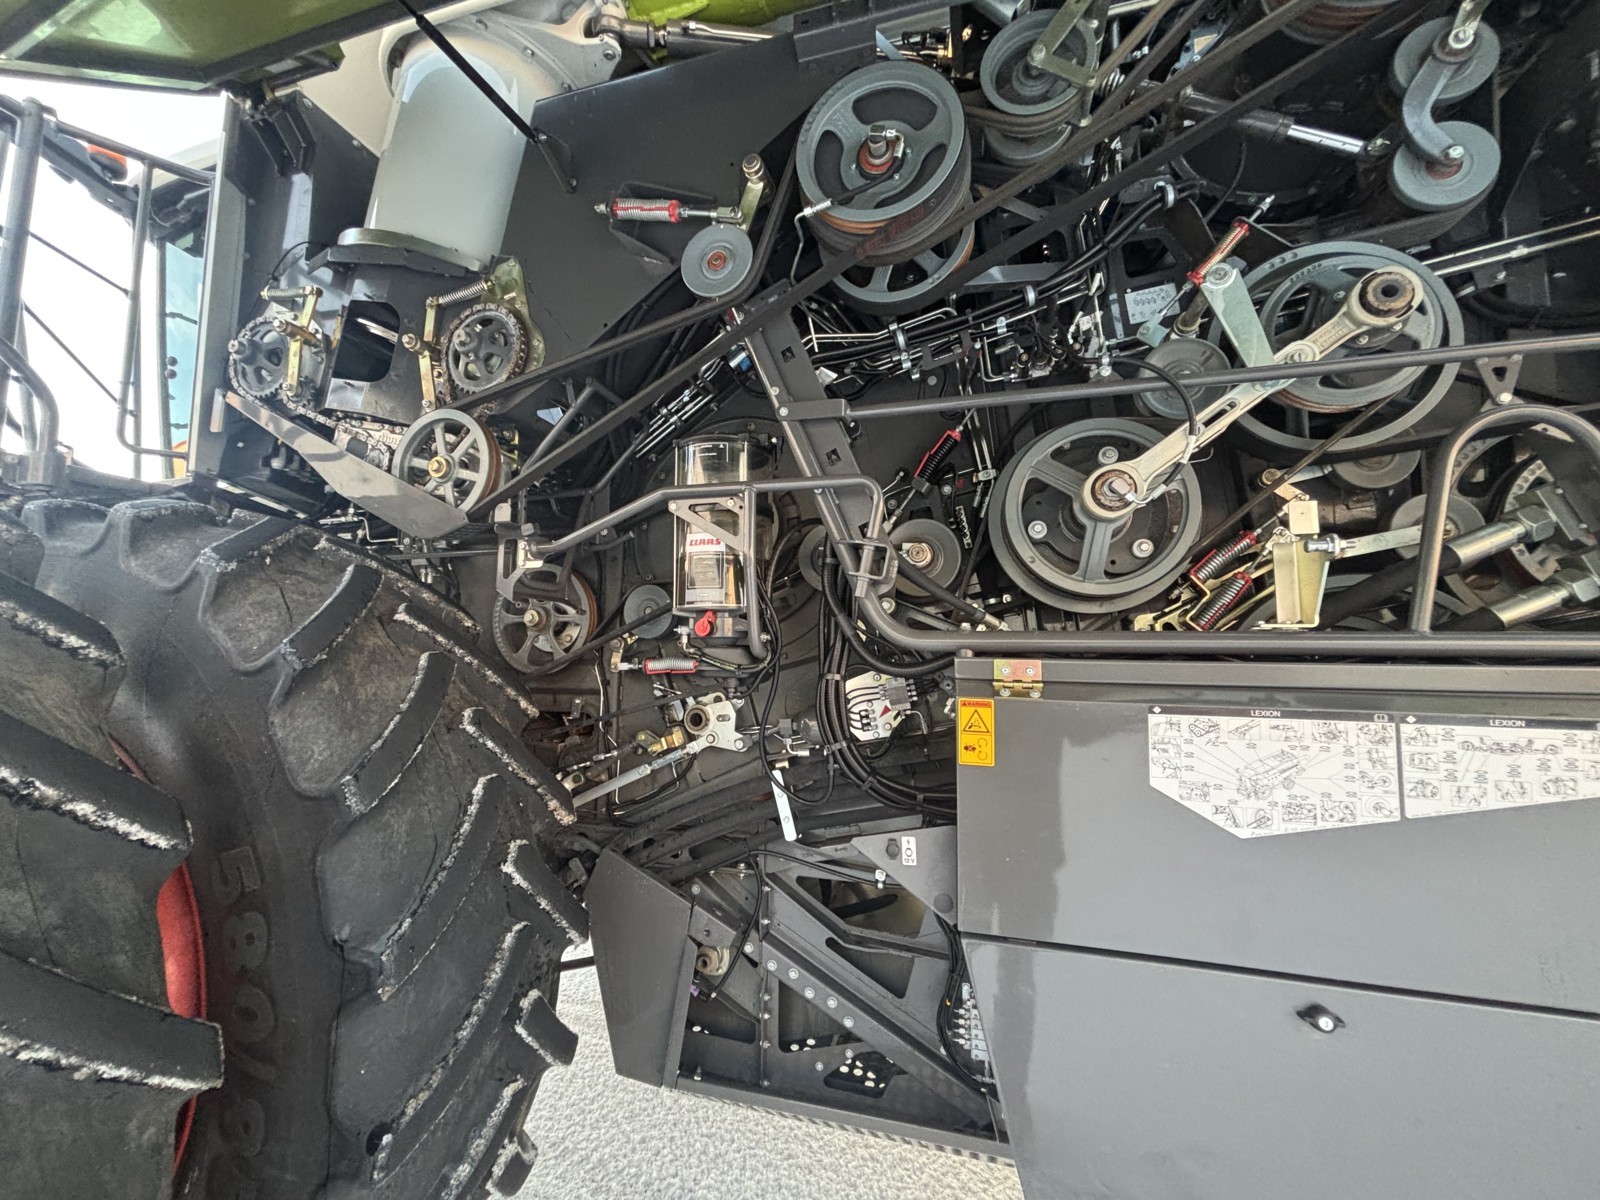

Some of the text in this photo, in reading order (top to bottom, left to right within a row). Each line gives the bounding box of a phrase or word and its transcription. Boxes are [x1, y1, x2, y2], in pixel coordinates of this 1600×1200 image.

[689, 538, 721, 547] CLAAS
[1250, 709, 1281, 717] LEXION
[1490, 719, 1526, 727] LEXION
